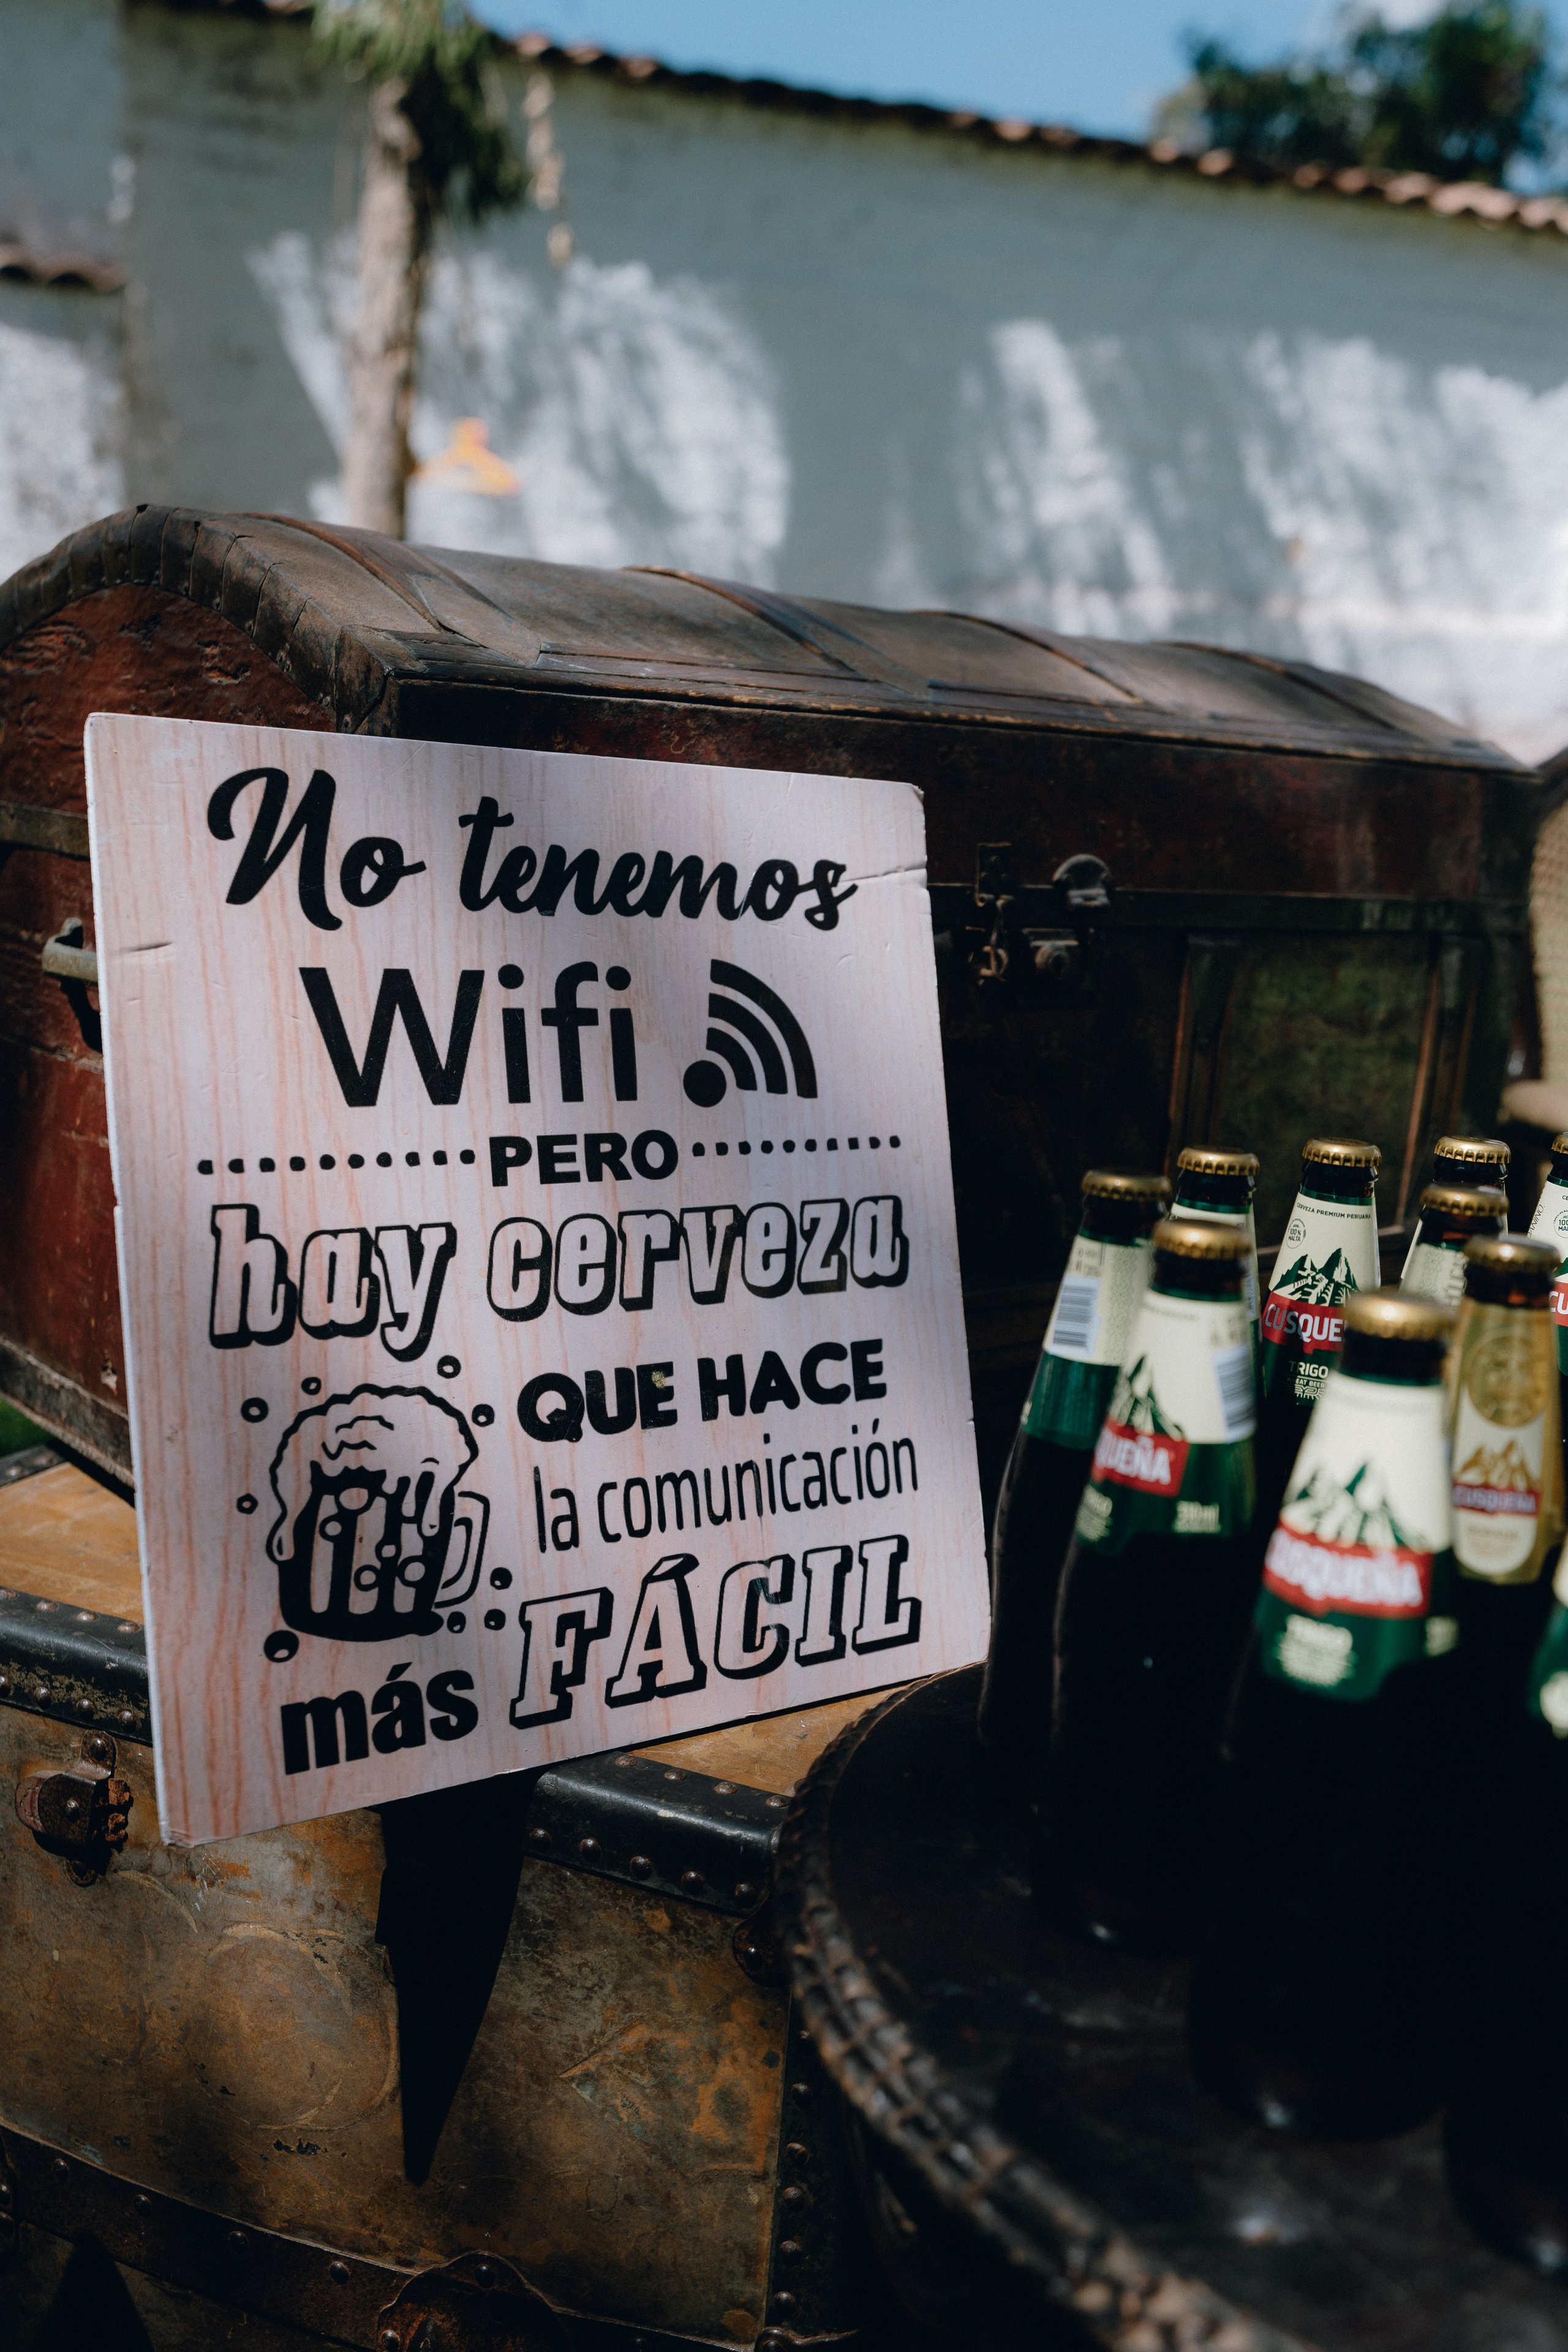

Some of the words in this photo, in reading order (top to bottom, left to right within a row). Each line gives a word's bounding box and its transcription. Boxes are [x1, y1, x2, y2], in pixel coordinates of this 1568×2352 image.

[207, 767, 427, 931] No
[458, 796, 858, 931] tenemos
[298, 960, 638, 1107] Wifi
[489, 1129, 679, 1187] PERO
[1296, 1202, 1315, 1214] CERVEZA
[1316, 1209, 1346, 1218] PREMIUM
[208, 1203, 458, 1363] hay
[486, 1194, 910, 1322] cerveza
[1265, 1303, 1348, 1343] CUSQUE
[517, 1362, 678, 1443] QUE
[697, 1338, 887, 1422] HACE
[1289, 1360, 1329, 1379] TRIGO
[1308, 1380, 1325, 1389] BEER
[533, 1466, 580, 1554] la
[597, 1418, 918, 1544] comunicación
[280, 1661, 479, 1776] más
[508, 1534, 922, 1730] FÁCIL
